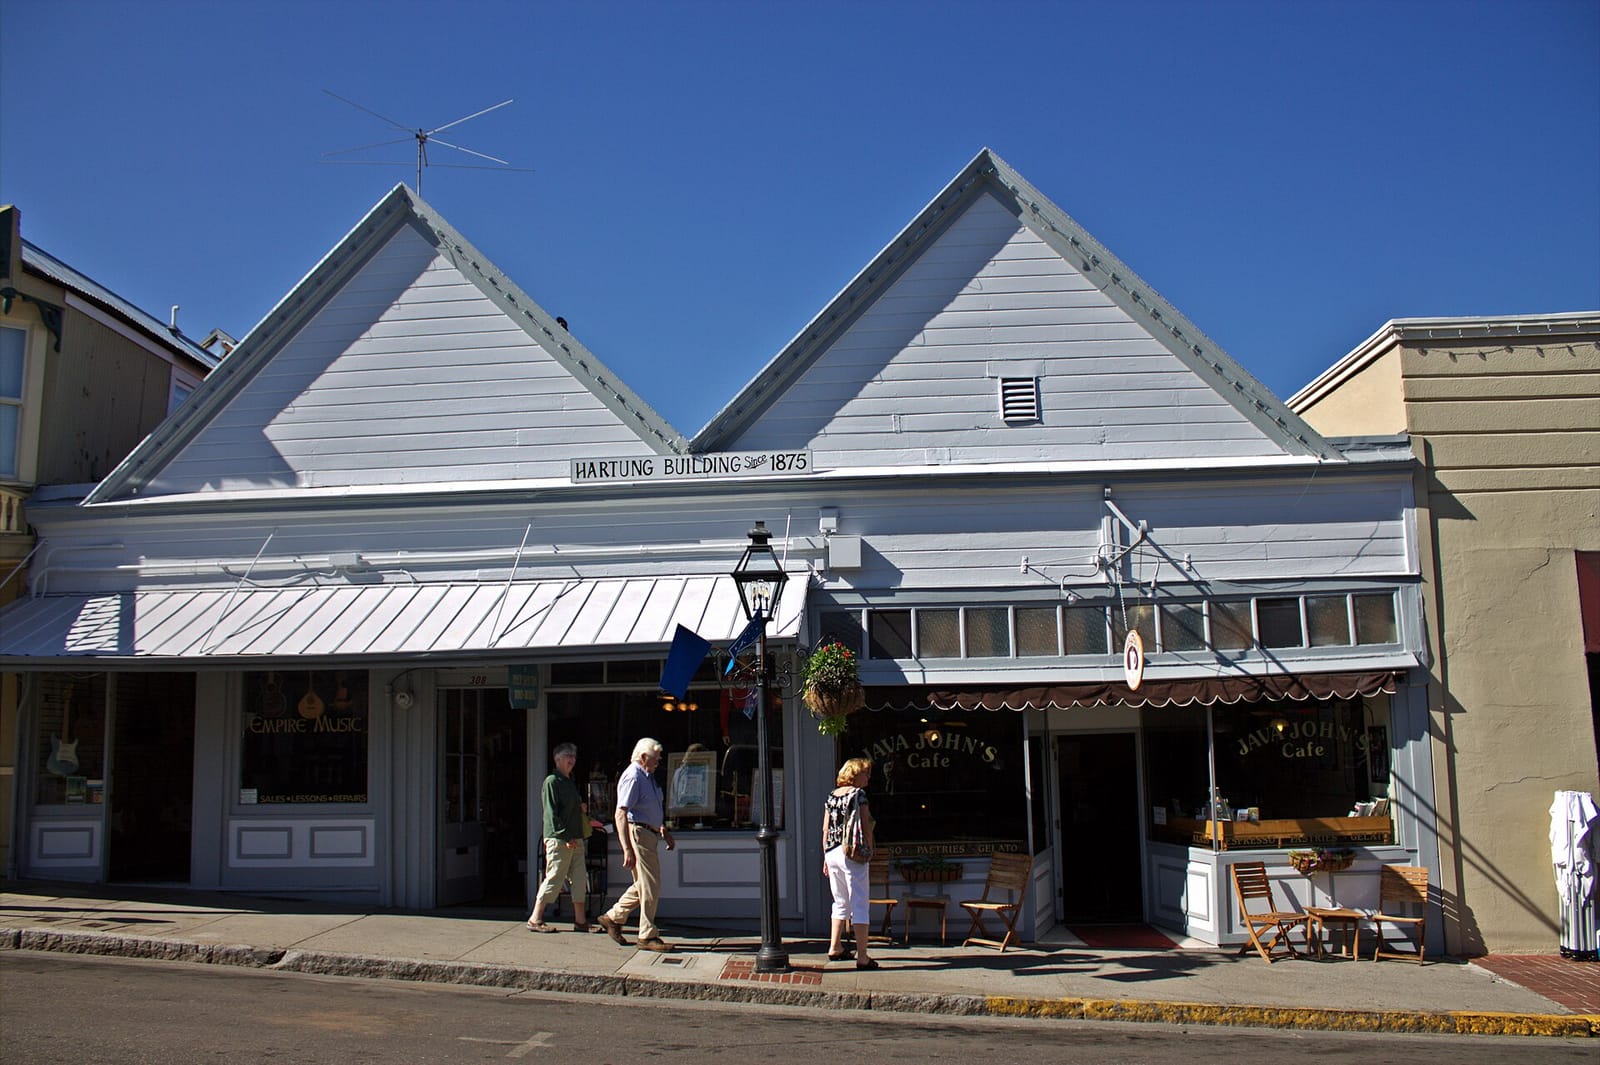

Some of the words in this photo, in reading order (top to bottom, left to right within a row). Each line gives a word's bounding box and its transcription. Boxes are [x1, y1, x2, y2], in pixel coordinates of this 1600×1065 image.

[575, 459, 654, 479] HARTUNG
[664, 456, 741, 475] BUILDING
[744, 454, 768, 470] Since
[770, 453, 807, 471] 1875
[249, 716, 308, 734] EMPIRE
[313, 715, 362, 733] MUSIC
[861, 733, 910, 762] JAVA
[915, 731, 998, 763] JOHN'S
[1235, 727, 1284, 756] JAVA
[1289, 720, 1369, 751] JOHN'S
[1282, 741, 1326, 758] Cafe
[907, 752, 951, 768] Cafe
[259, 794, 285, 803] SALES
[291, 794, 328, 802] LESSONS
[332, 794, 367, 802] REPAIRS
[917, 844, 966, 855] PASTRIES
